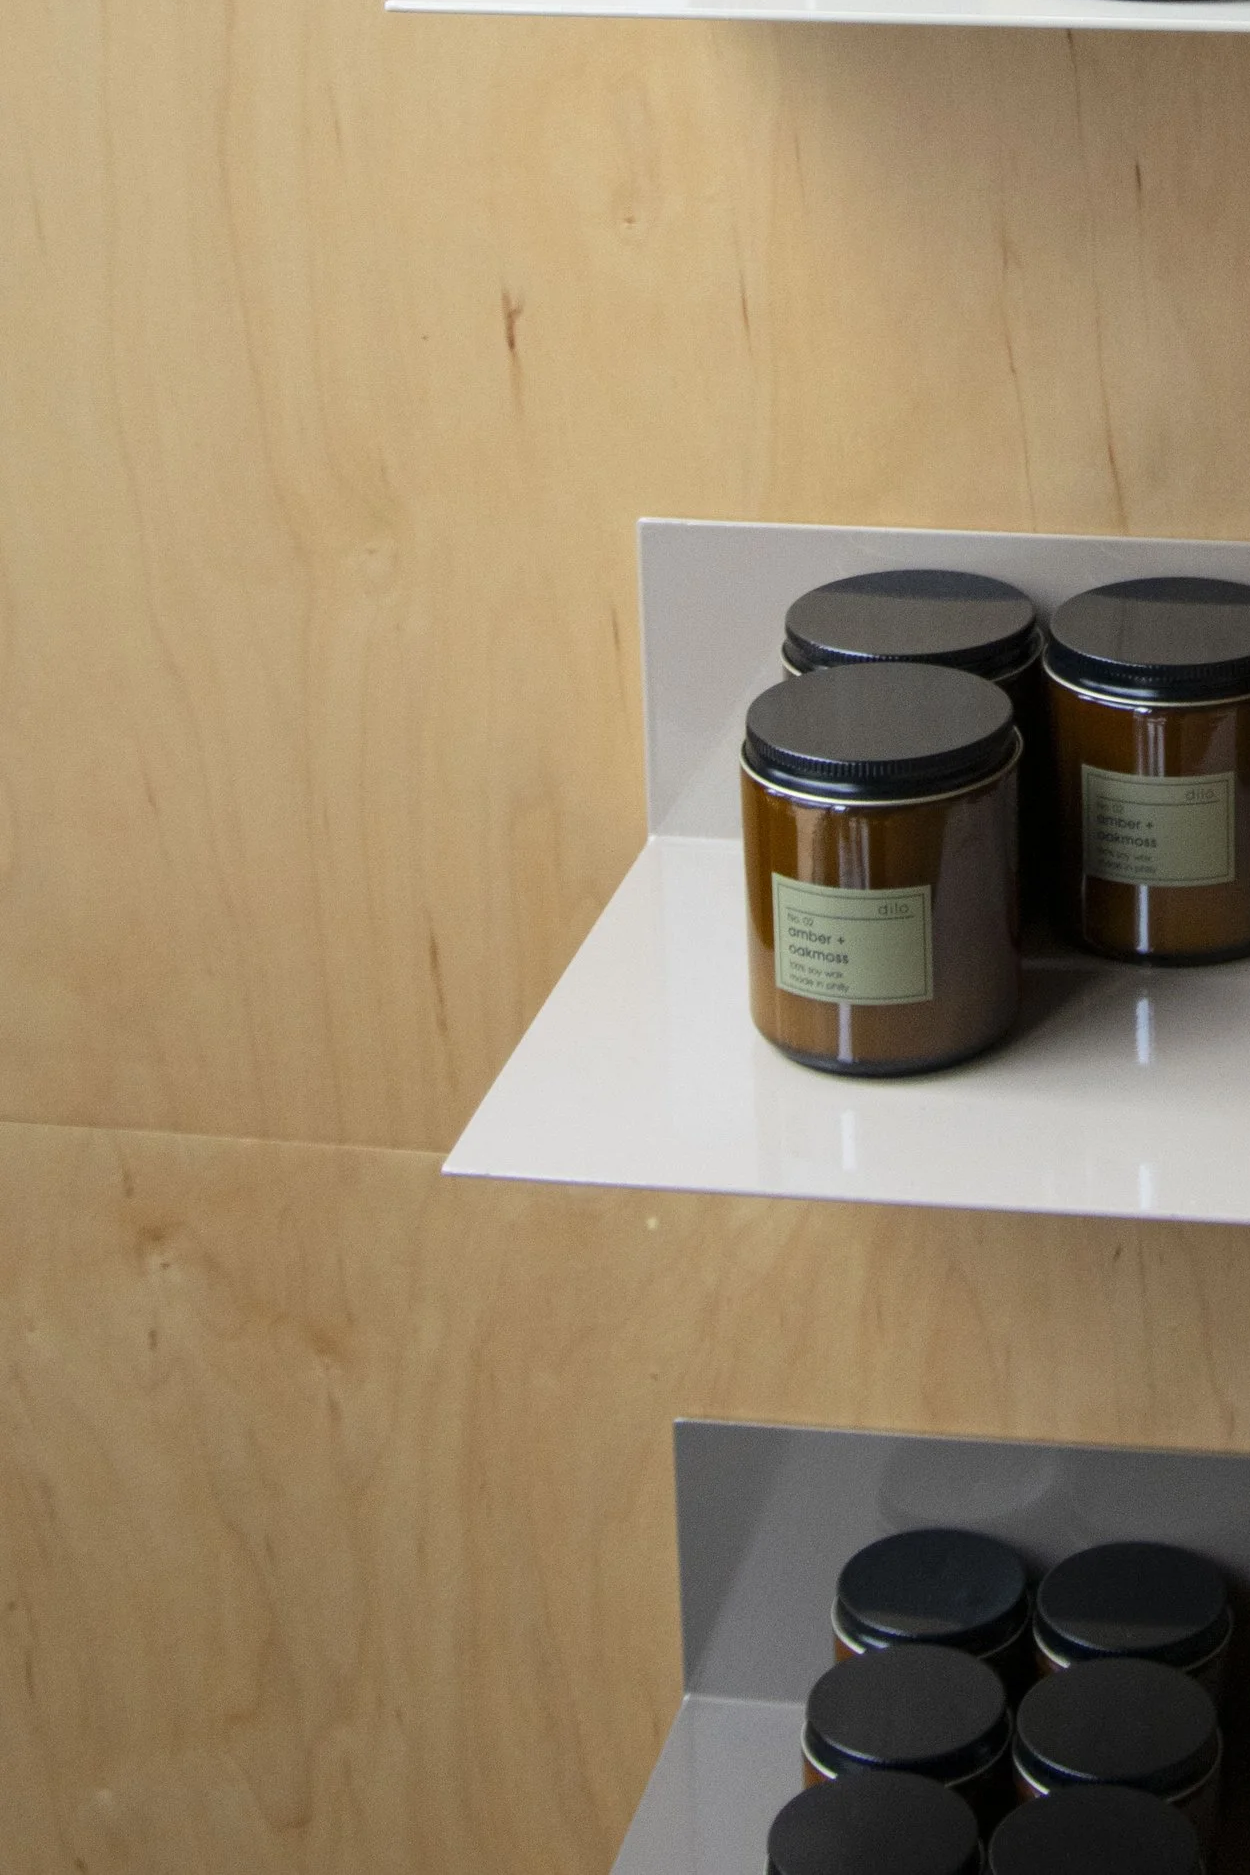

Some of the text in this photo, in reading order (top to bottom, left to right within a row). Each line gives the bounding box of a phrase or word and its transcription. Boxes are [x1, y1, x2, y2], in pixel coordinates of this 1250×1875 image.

[878, 902, 910, 916] dilo
[788, 926, 845, 945] amber +
[788, 944, 849, 965] oakmoss
